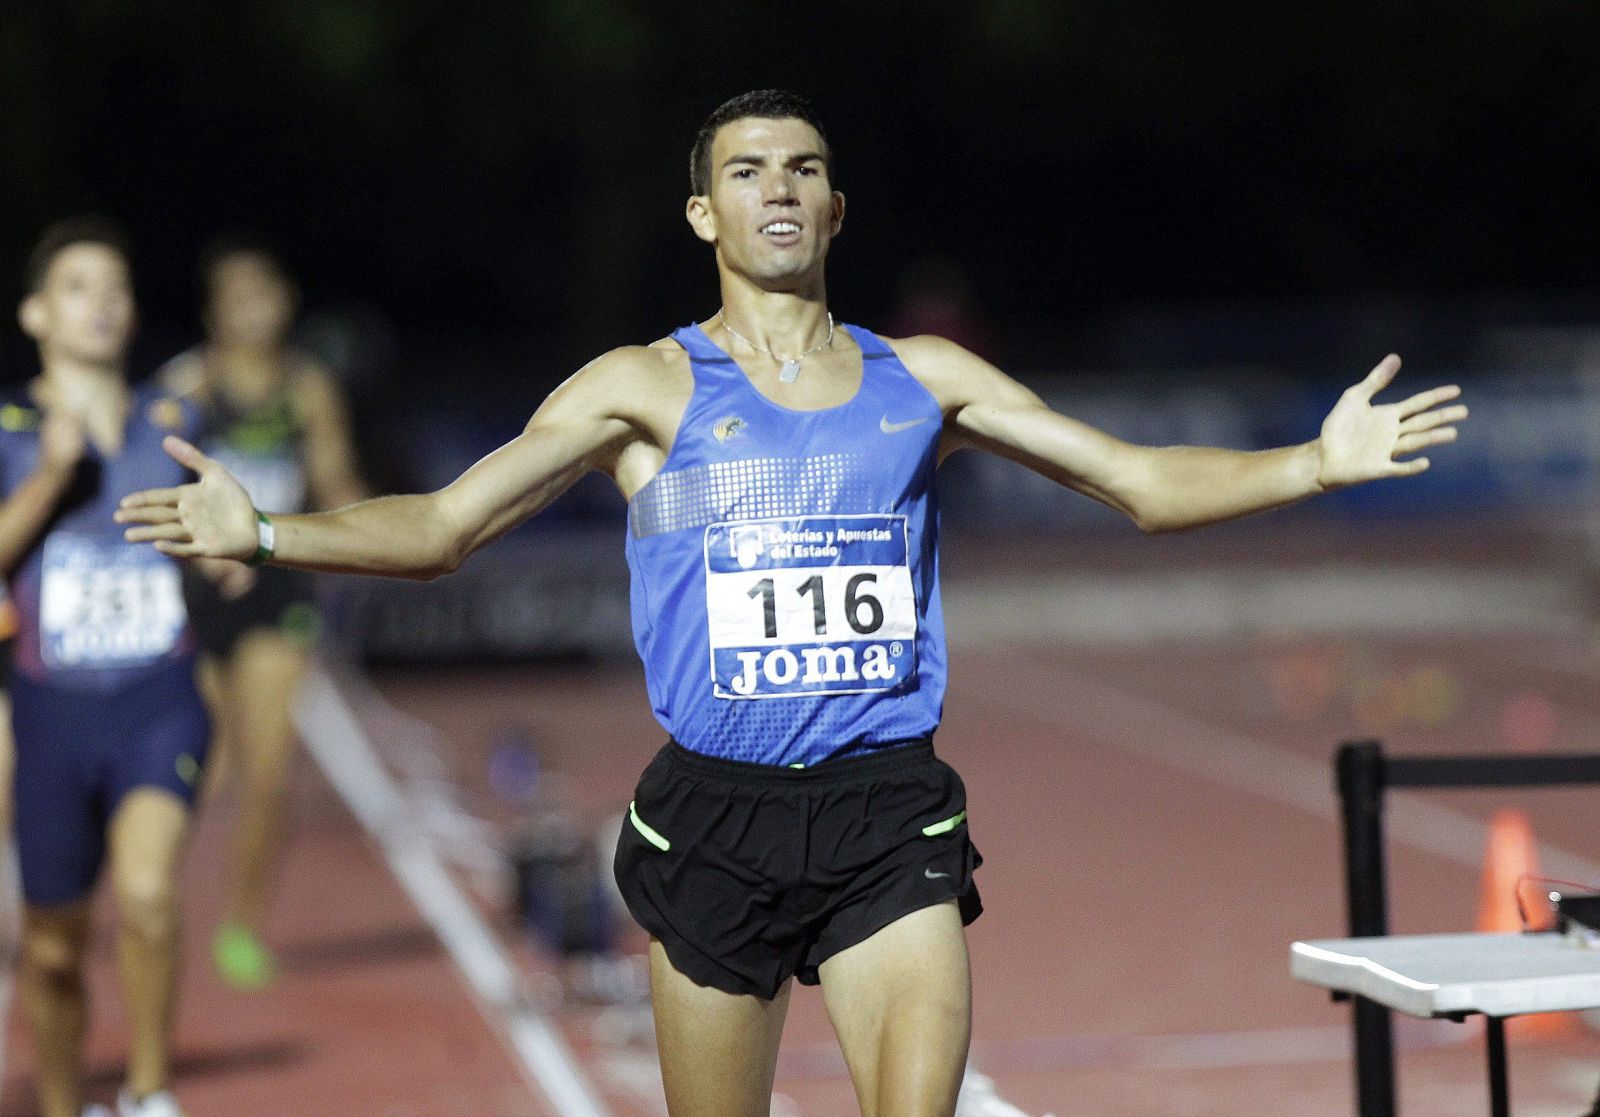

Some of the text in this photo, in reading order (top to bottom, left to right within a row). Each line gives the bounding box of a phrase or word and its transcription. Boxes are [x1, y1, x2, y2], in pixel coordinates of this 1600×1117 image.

[825, 531, 835, 545] y
[837, 528, 892, 544] Apuestas
[770, 544, 838, 559] del Estado
[746, 572, 884, 639] 116
